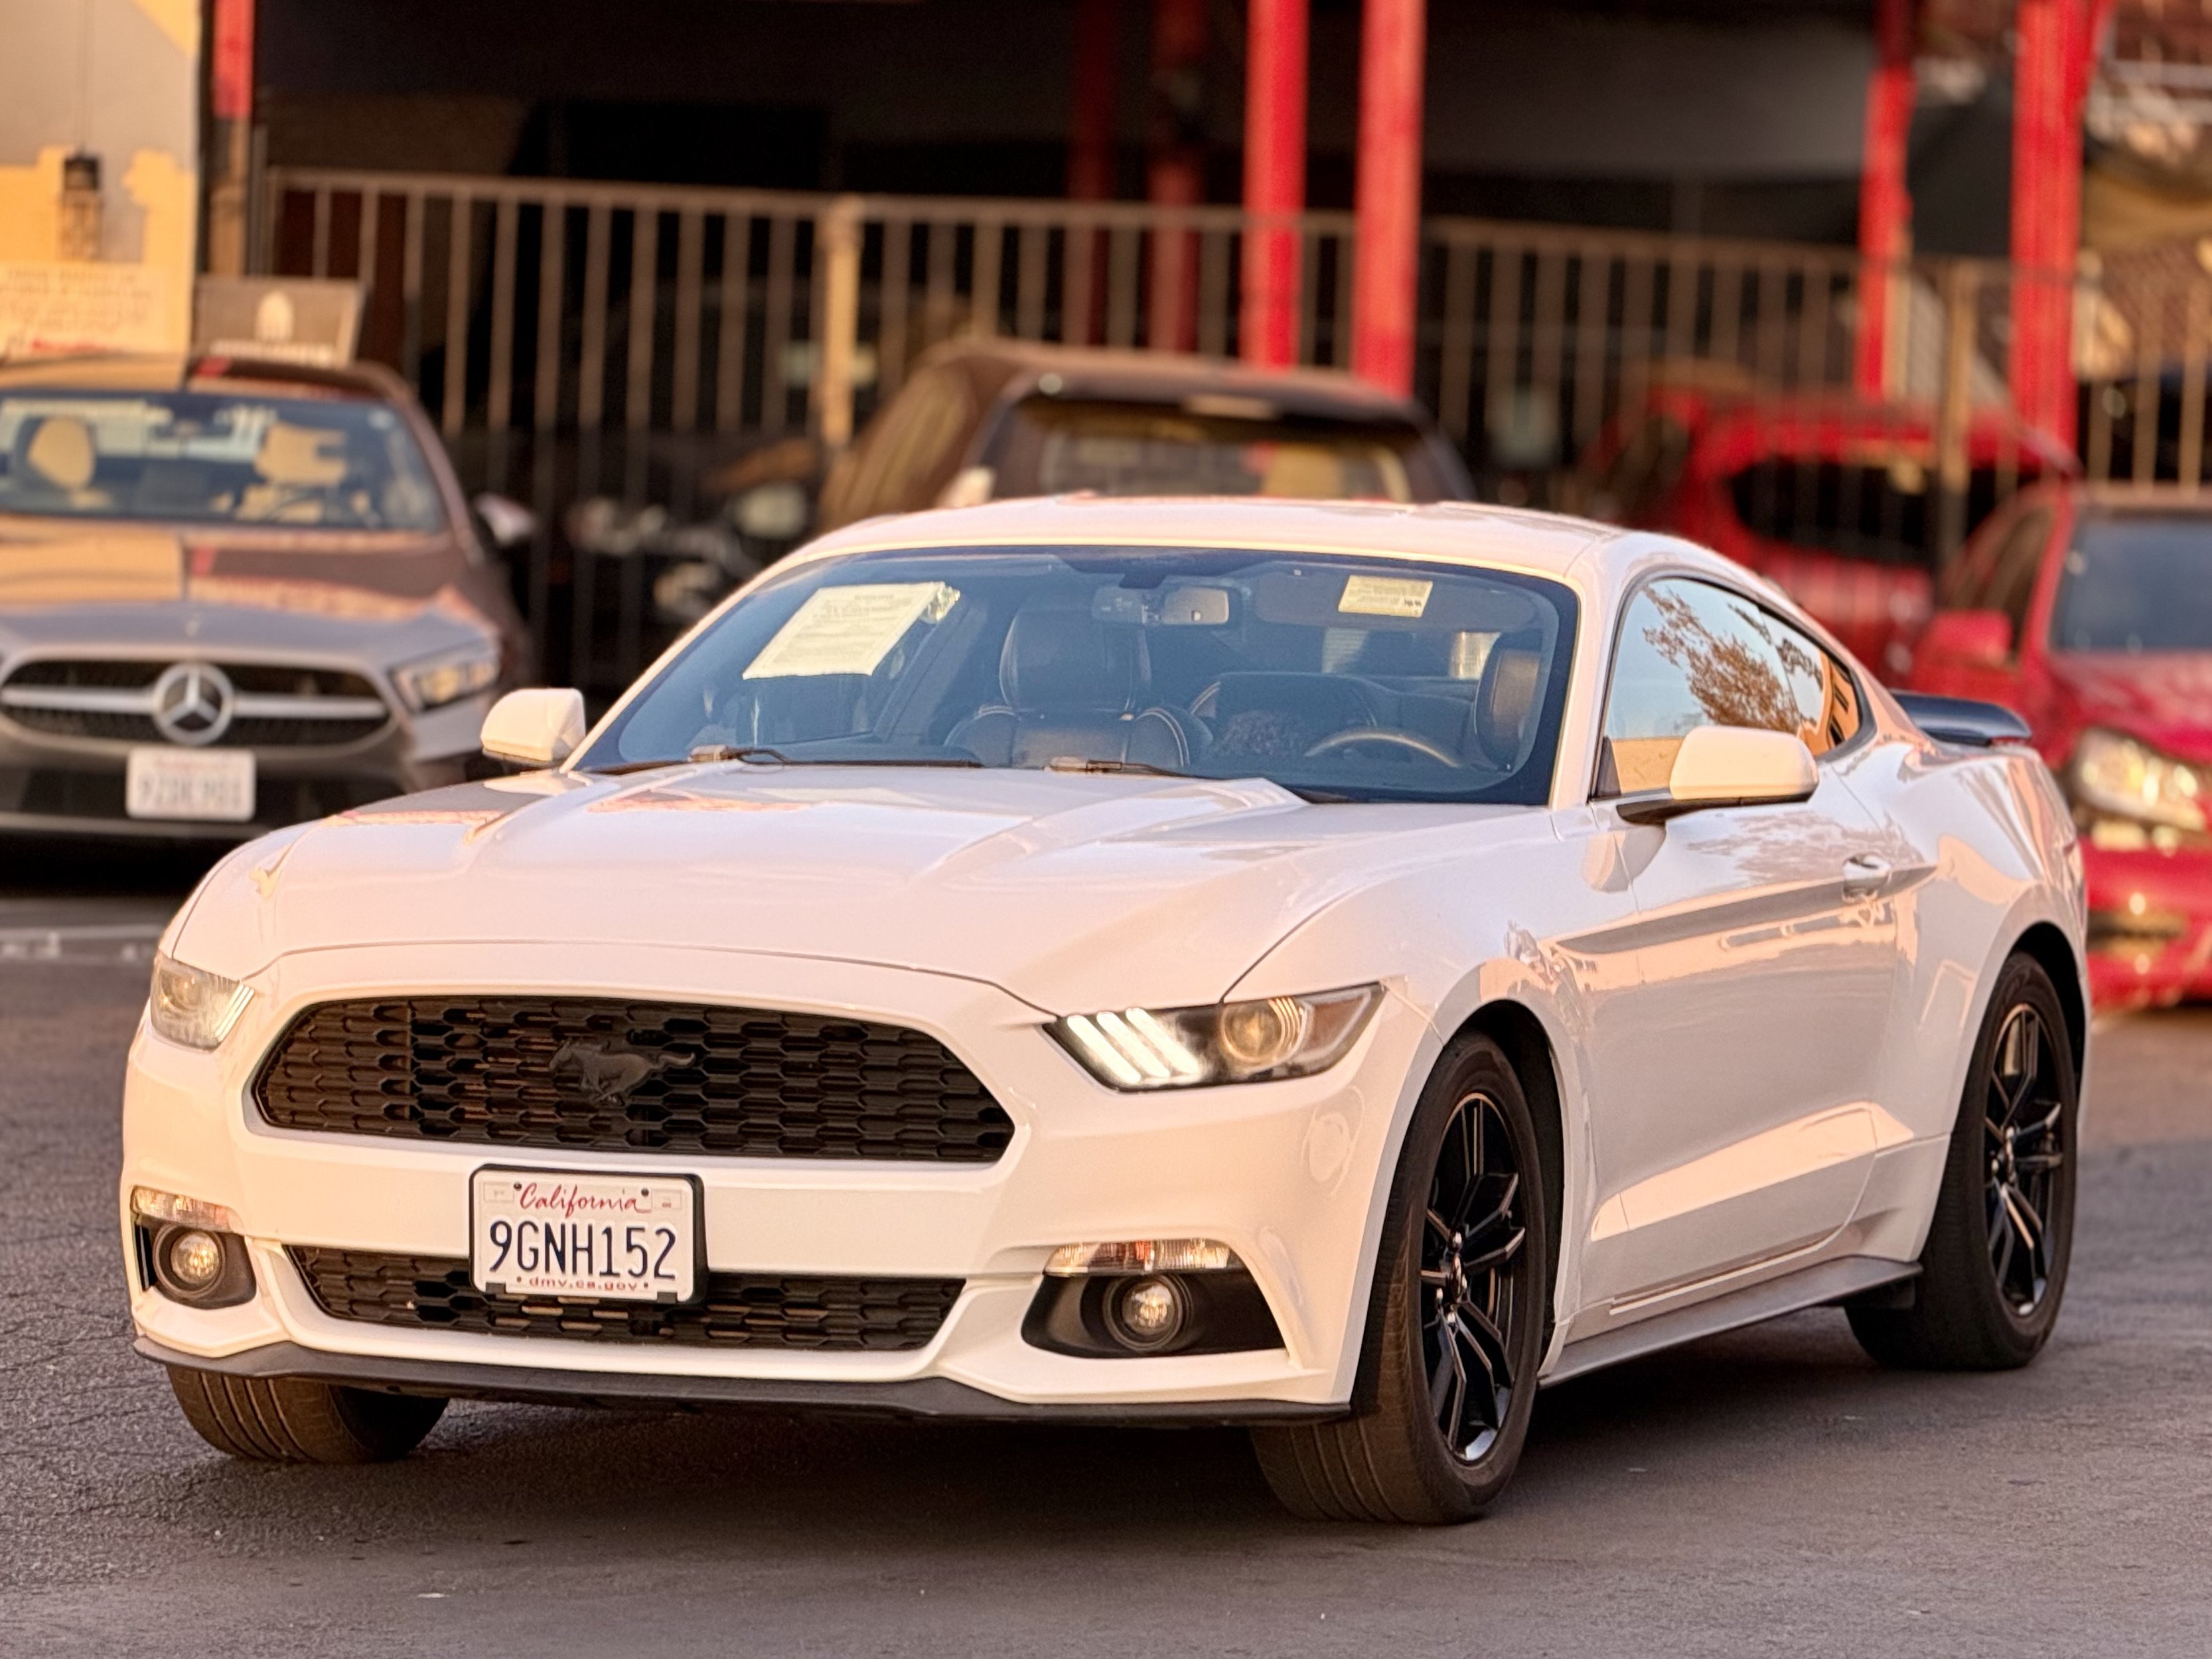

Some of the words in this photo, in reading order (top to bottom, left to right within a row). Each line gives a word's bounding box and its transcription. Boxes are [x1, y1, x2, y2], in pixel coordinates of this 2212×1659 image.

[520, 1183, 652, 1218] California
[490, 1220, 676, 1280] 9GNH152
[529, 1276, 638, 1291] dmv.ca.gov
